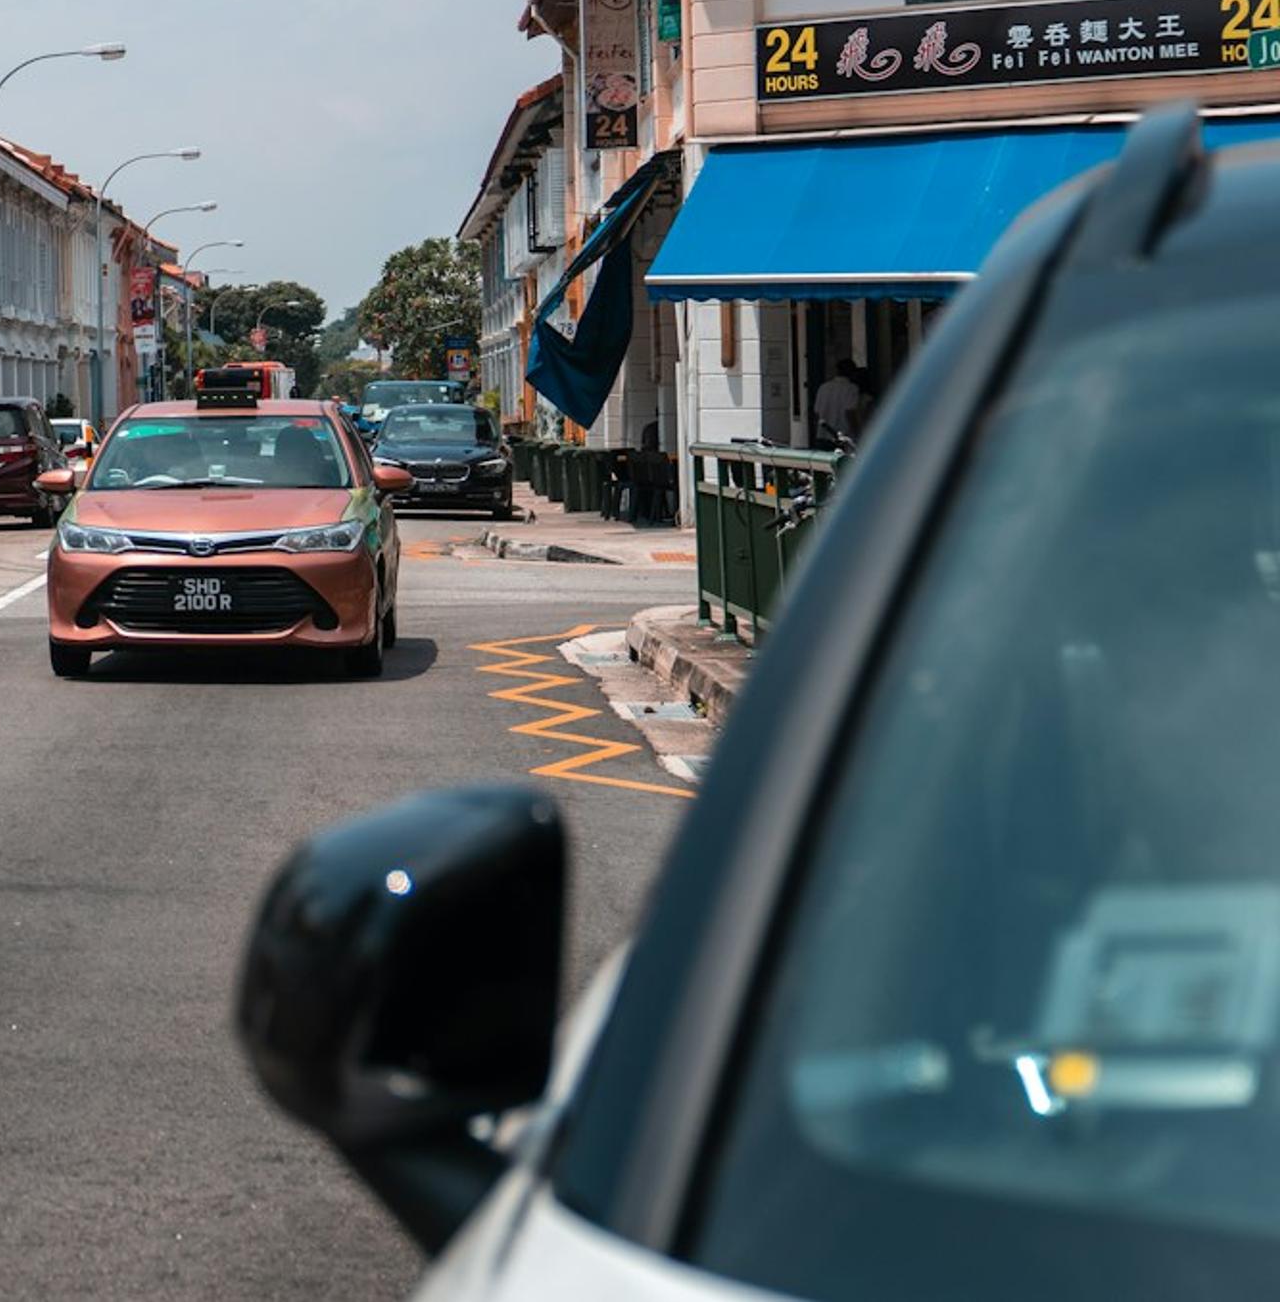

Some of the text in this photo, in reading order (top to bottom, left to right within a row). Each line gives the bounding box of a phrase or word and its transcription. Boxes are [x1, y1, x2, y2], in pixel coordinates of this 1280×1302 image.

[766, 27, 818, 72] 24
[992, 43, 1200, 70] Fei Fei WANTON MEE
[765, 74, 819, 93] HOURS
[595, 114, 628, 136] 24
[183, 578, 220, 594] SHD
[174, 594, 232, 610] 2100 R
